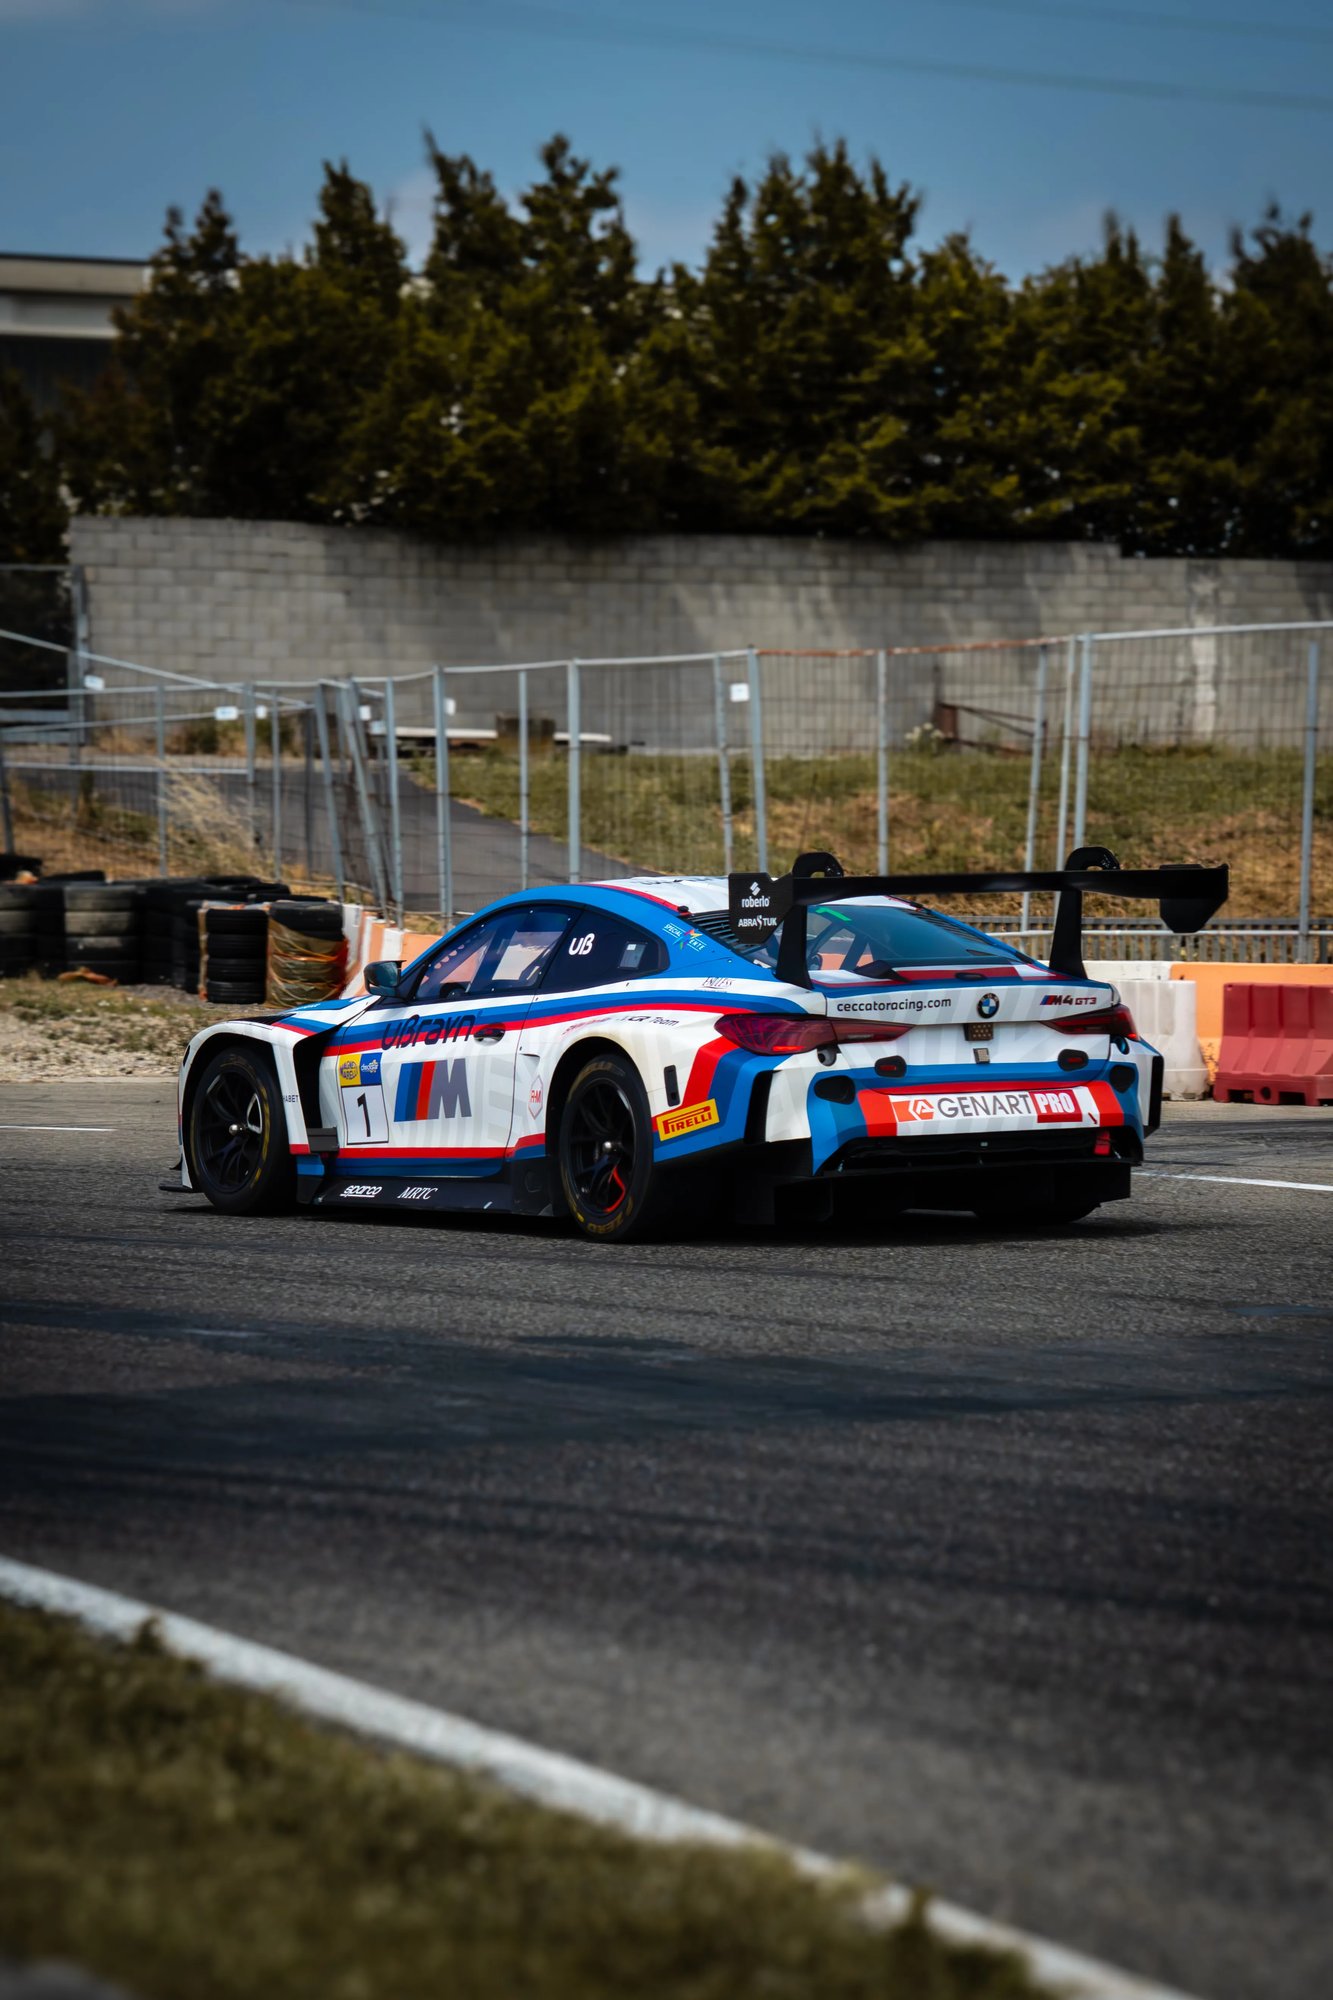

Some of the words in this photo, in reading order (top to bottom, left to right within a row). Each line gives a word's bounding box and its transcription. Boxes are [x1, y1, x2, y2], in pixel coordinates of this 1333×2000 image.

[742, 896, 769, 908] roberlo
[837, 999, 951, 1011] ceccatoracing.com
[1075, 997, 1097, 1005] GT3
[937, 1094, 1032, 1118] GENART
[1035, 1092, 1076, 1114] PRO
[357, 1093, 371, 1137] 1
[663, 1106, 712, 1134] PIRELLI
[342, 1185, 382, 1197] sparco
[397, 1187, 438, 1199] MRTC
